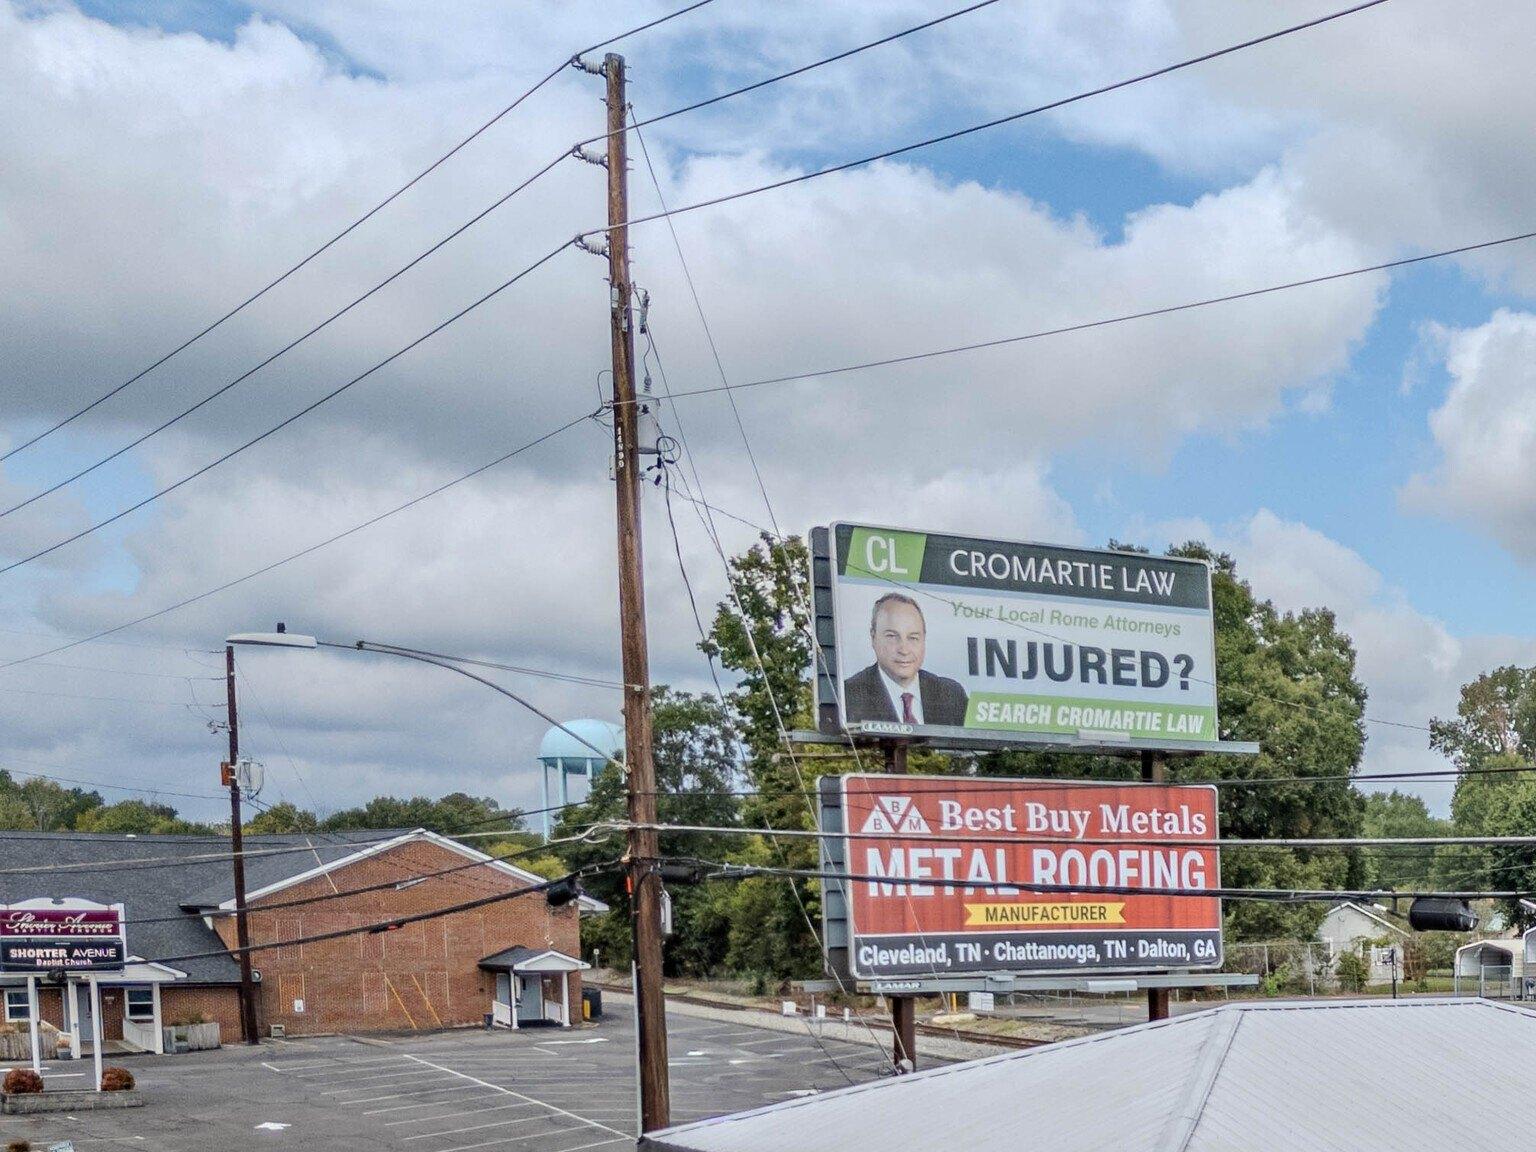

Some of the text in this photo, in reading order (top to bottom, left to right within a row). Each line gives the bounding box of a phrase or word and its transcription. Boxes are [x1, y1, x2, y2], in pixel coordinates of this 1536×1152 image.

[866, 535, 908, 574] CL
[950, 549, 1176, 597] CROMARTIE LAW
[951, 601, 1181, 638] Your Local Rome Attorneys
[966, 636, 1195, 691] INJURED?
[975, 701, 1205, 734] SEARCH CROMARTIE LAW
[938, 800, 1207, 839] Best Buy Metals
[867, 847, 1206, 897] METAL ROOFING
[985, 905, 1107, 922] MANUFACTURER
[9, 948, 117, 958] SHORTER AVENUE
[859, 938, 1217, 967] Cleveland, TN Chattanooga, TN Dalton, GA
